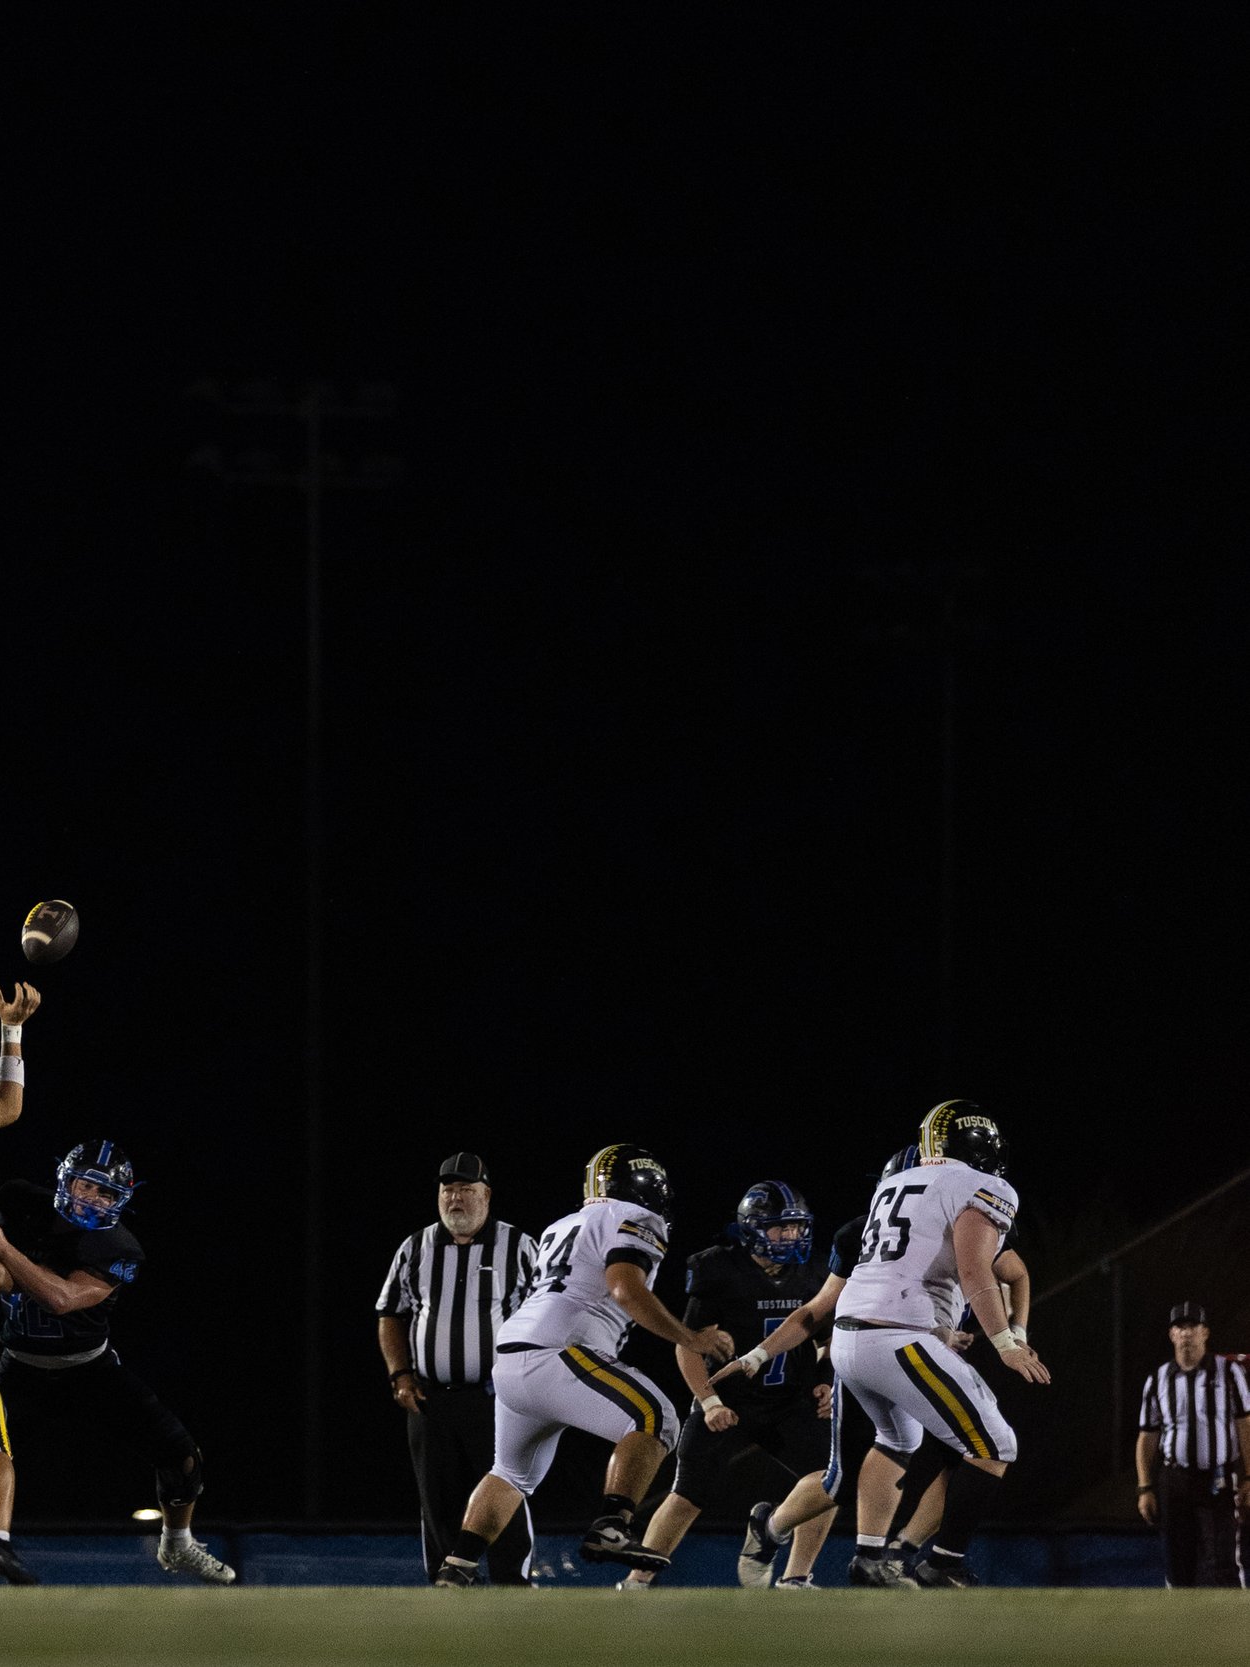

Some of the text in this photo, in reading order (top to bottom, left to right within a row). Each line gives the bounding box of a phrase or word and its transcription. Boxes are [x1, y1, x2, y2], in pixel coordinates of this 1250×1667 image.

[858, 1184, 928, 1263] 65
[109, 1258, 138, 1284] 42
[756, 1299, 803, 1310] MUSTANGS
[763, 1317, 789, 1387] 7
